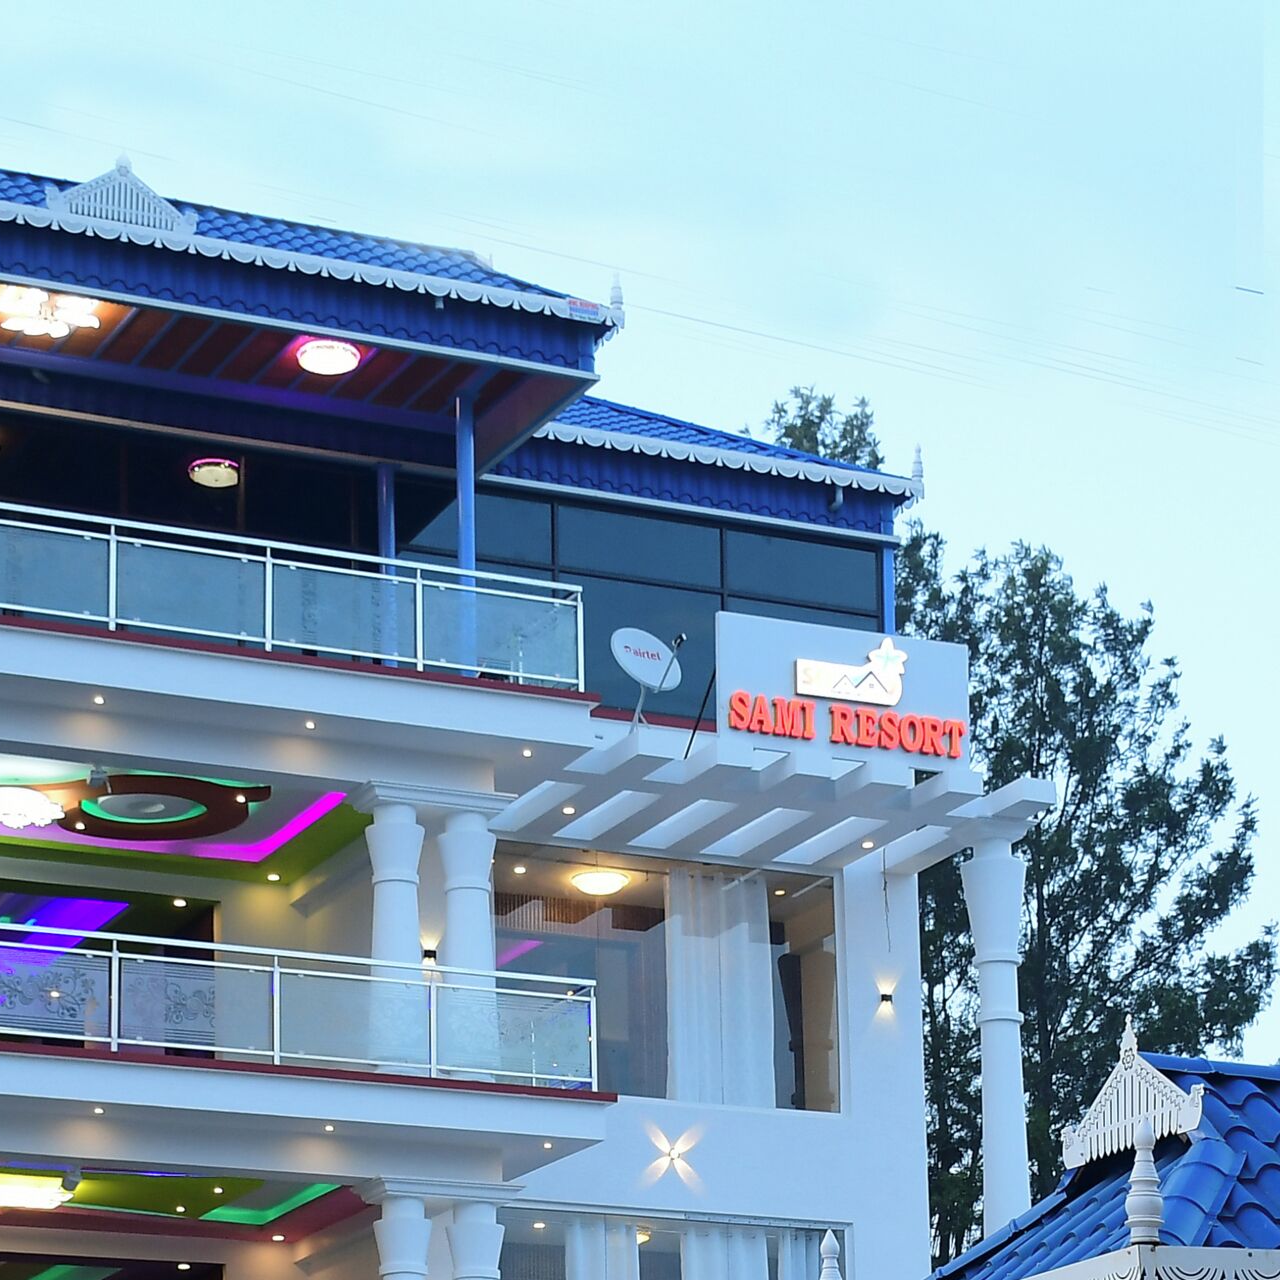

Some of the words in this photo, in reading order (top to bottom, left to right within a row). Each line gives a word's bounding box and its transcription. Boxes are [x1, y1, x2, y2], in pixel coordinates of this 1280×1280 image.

[632, 647, 662, 661] airtel
[728, 689, 817, 740] SAMI
[828, 703, 967, 760] RESORT
